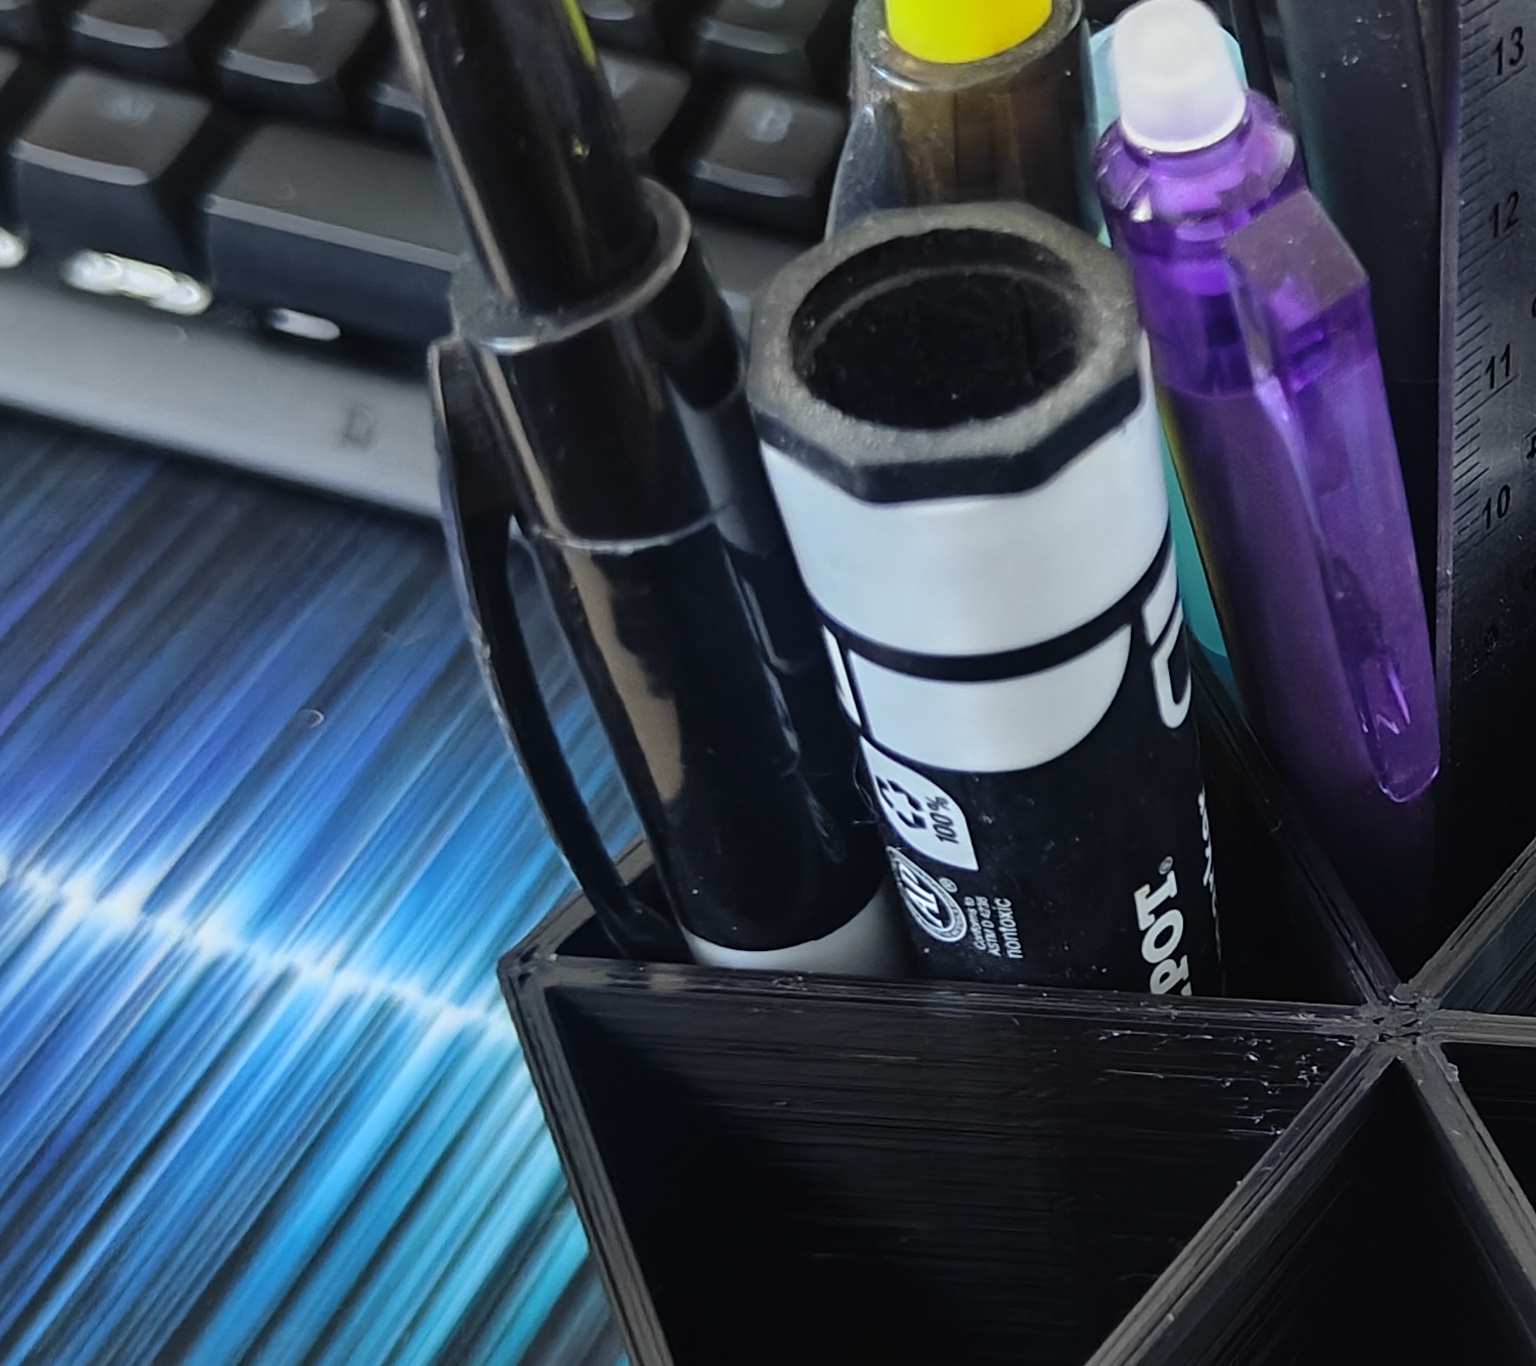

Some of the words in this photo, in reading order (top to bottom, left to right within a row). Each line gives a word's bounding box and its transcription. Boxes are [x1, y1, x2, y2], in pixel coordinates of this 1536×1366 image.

[1491, 26, 1524, 76] 13
[1488, 190, 1520, 238] 12
[1484, 343, 1511, 390] 11
[1481, 484, 1511, 530] 10
[926, 794, 960, 845] 100%
[898, 863, 943, 927] AP
[991, 897, 1024, 959] nontoxic
[1134, 870, 1193, 997] POT
